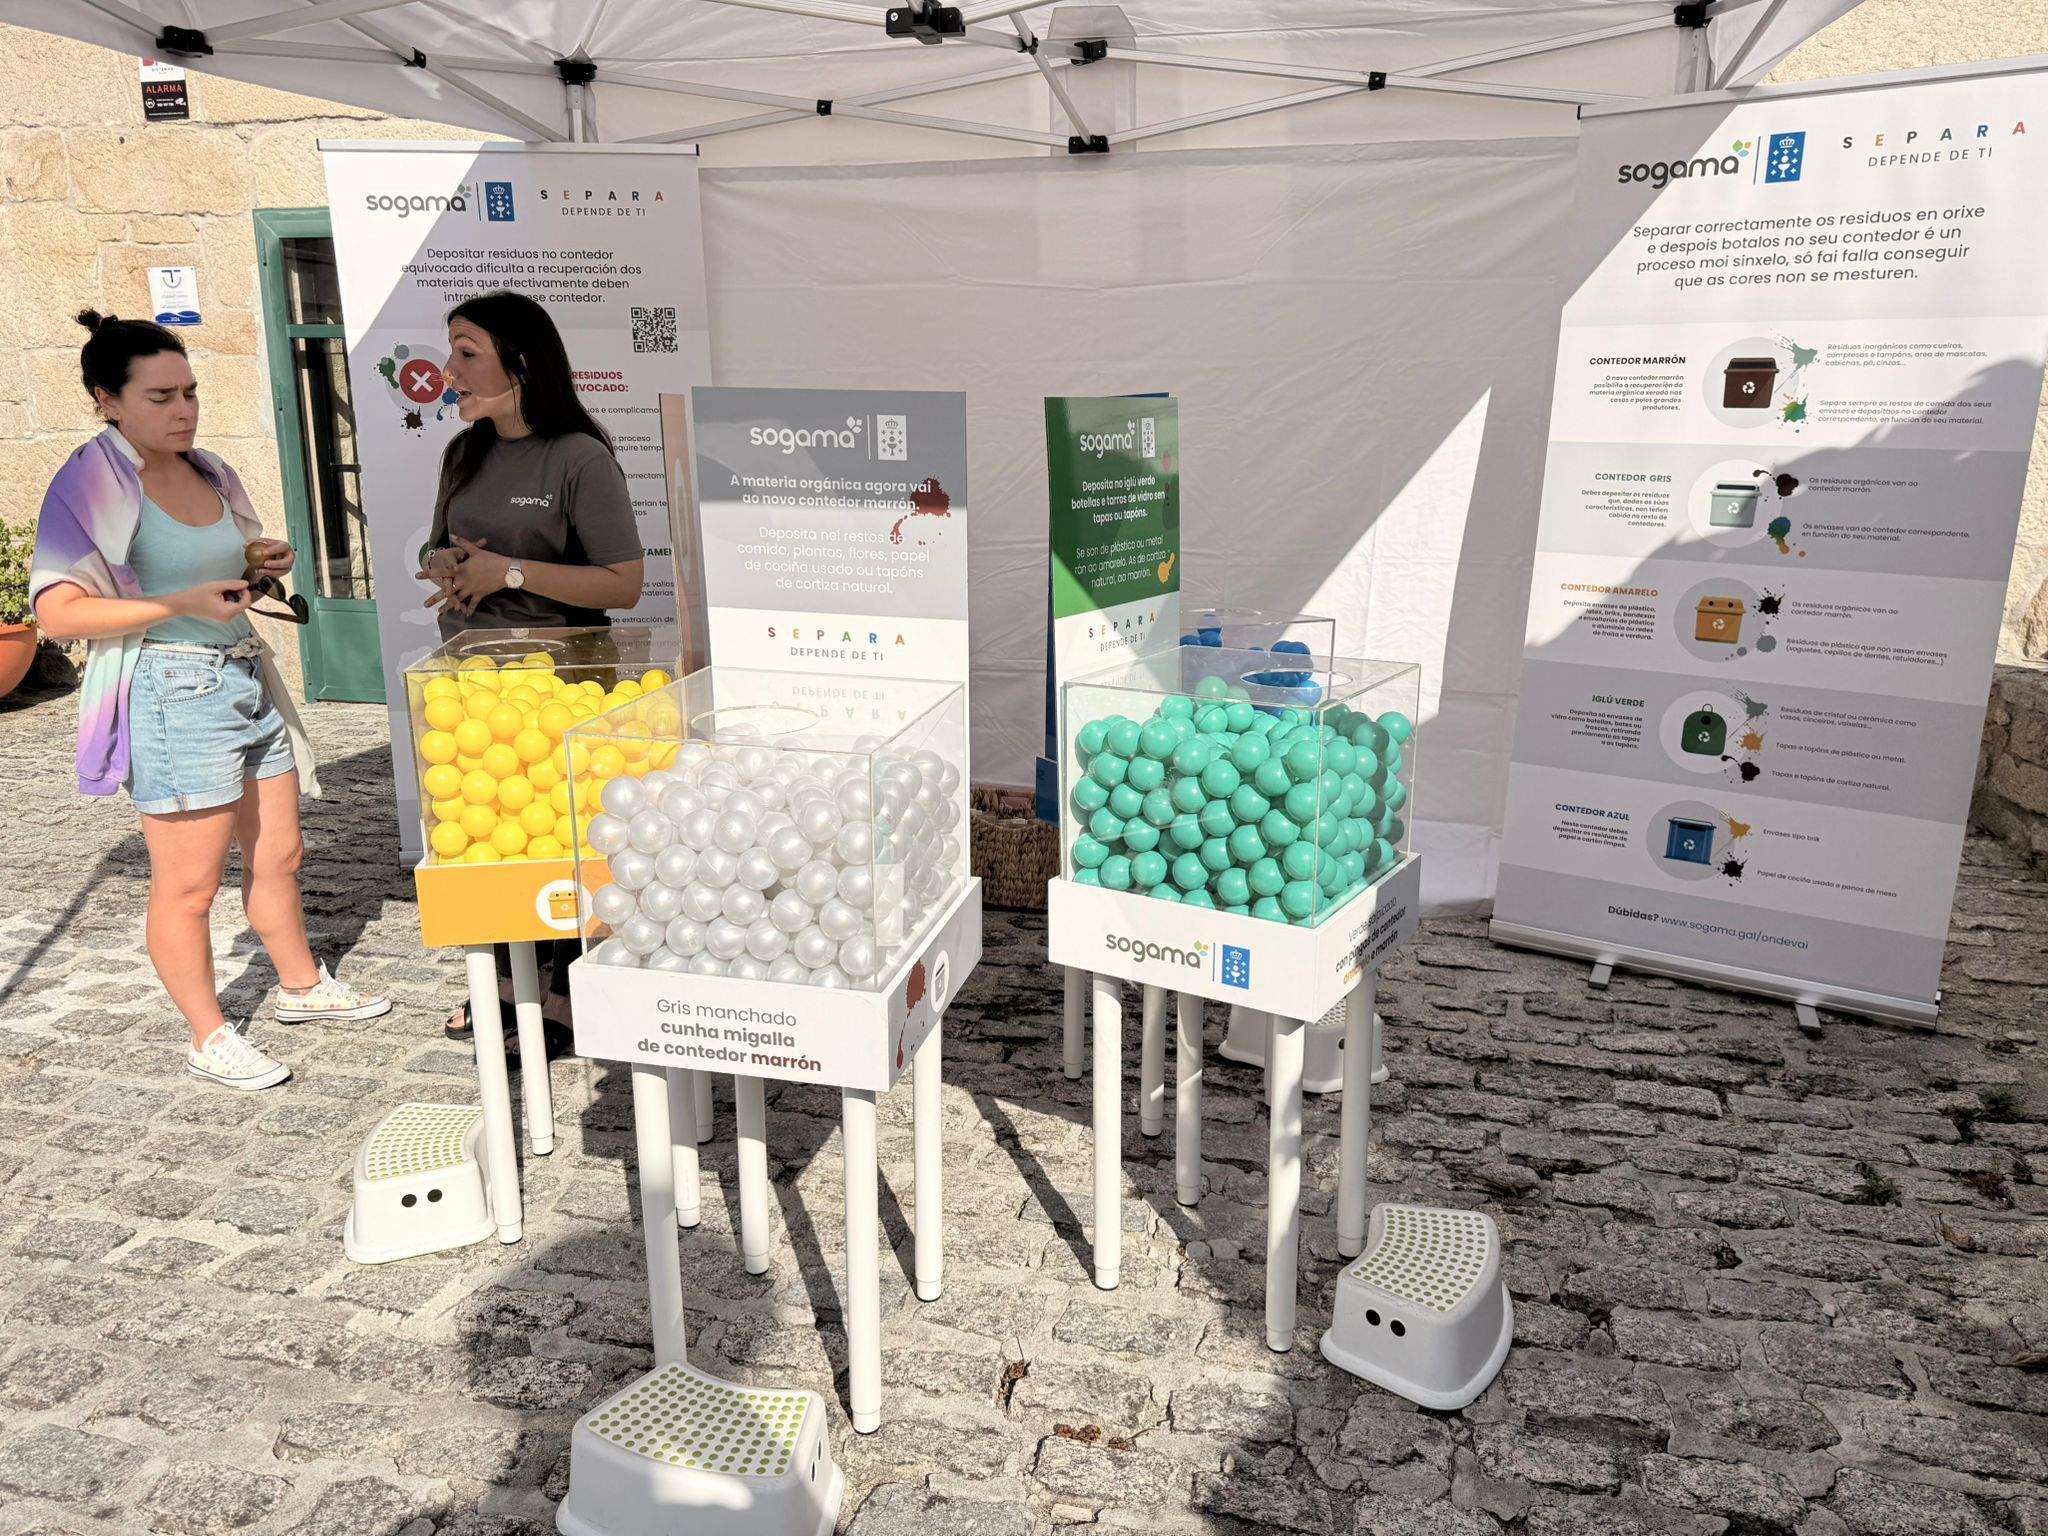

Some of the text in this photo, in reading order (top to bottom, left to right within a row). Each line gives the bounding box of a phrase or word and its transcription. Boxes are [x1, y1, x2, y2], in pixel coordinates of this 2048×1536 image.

[146, 84, 182, 94] ALARMA
[1843, 121, 2026, 150] SEPARA
[1868, 147, 1993, 167] DEPENDE DE TI
[1618, 154, 1739, 190] sogama
[540, 189, 664, 202] SEPARA
[366, 194, 467, 218] sogama
[562, 206, 646, 216] DEPENDE DE TI
[1633, 205, 1985, 240] Separar correctamente os residuos en orixe
[1647, 226, 1962, 256] e despois botalos no seu contedor é un
[427, 248, 614, 262] Depositar residuos no contedor
[1637, 243, 1969, 276] proceso moi sinxelo, só fai falla conseguir
[402, 262, 474, 276] equivocado
[474, 262, 525, 273] dificulta
[538, 263, 618, 277] recuperación
[618, 263, 642, 274] dos
[416, 276, 629, 291] materiais que efectivamente deben
[1674, 267, 1918, 292] que as cores non se mesturen.
[550, 290, 606, 302] contedor.
[1589, 354, 1686, 365] CONTEDOR MARRÓN
[571, 372, 623, 380] RESIDUOS
[750, 426, 855, 454] sogama
[1079, 432, 1132, 458] sogama
[730, 474, 931, 494] A materia orgánica agora vai
[1082, 474, 1156, 494] Deposita no iglú verde
[1594, 474, 1646, 482] CONTEDOR
[510, 496, 549, 508] sogama
[742, 495, 920, 510] ao novo contedor marrón.
[1071, 490, 1165, 509] botellas e tarros de vidro sen
[1093, 507, 1148, 525] tapas ou tapóns.
[759, 527, 904, 543] Deposita nel restos de
[737, 542, 930, 564] comida, plantas, flores, papel
[745, 559, 924, 580] de cociña usado ou tapóns
[776, 576, 893, 593] de cortiza natural.
[1560, 583, 1658, 596] CONTEDOR AMARELO
[768, 627, 905, 646] SEPARA
[790, 648, 883, 660] DEPENDE DE TI
[1592, 694, 1644, 707] IGLÚ VERDE
[1555, 804, 1630, 820] CONTEDOR AZUL
[1608, 906, 1808, 949] Dúbidas? www.sogama.gal/ondevai
[1106, 934, 1200, 968] sogama
[657, 1001, 797, 1026] Gris manchado
[660, 1024, 795, 1047] cunha migalla
[637, 1039, 822, 1070] de contedor marrón
